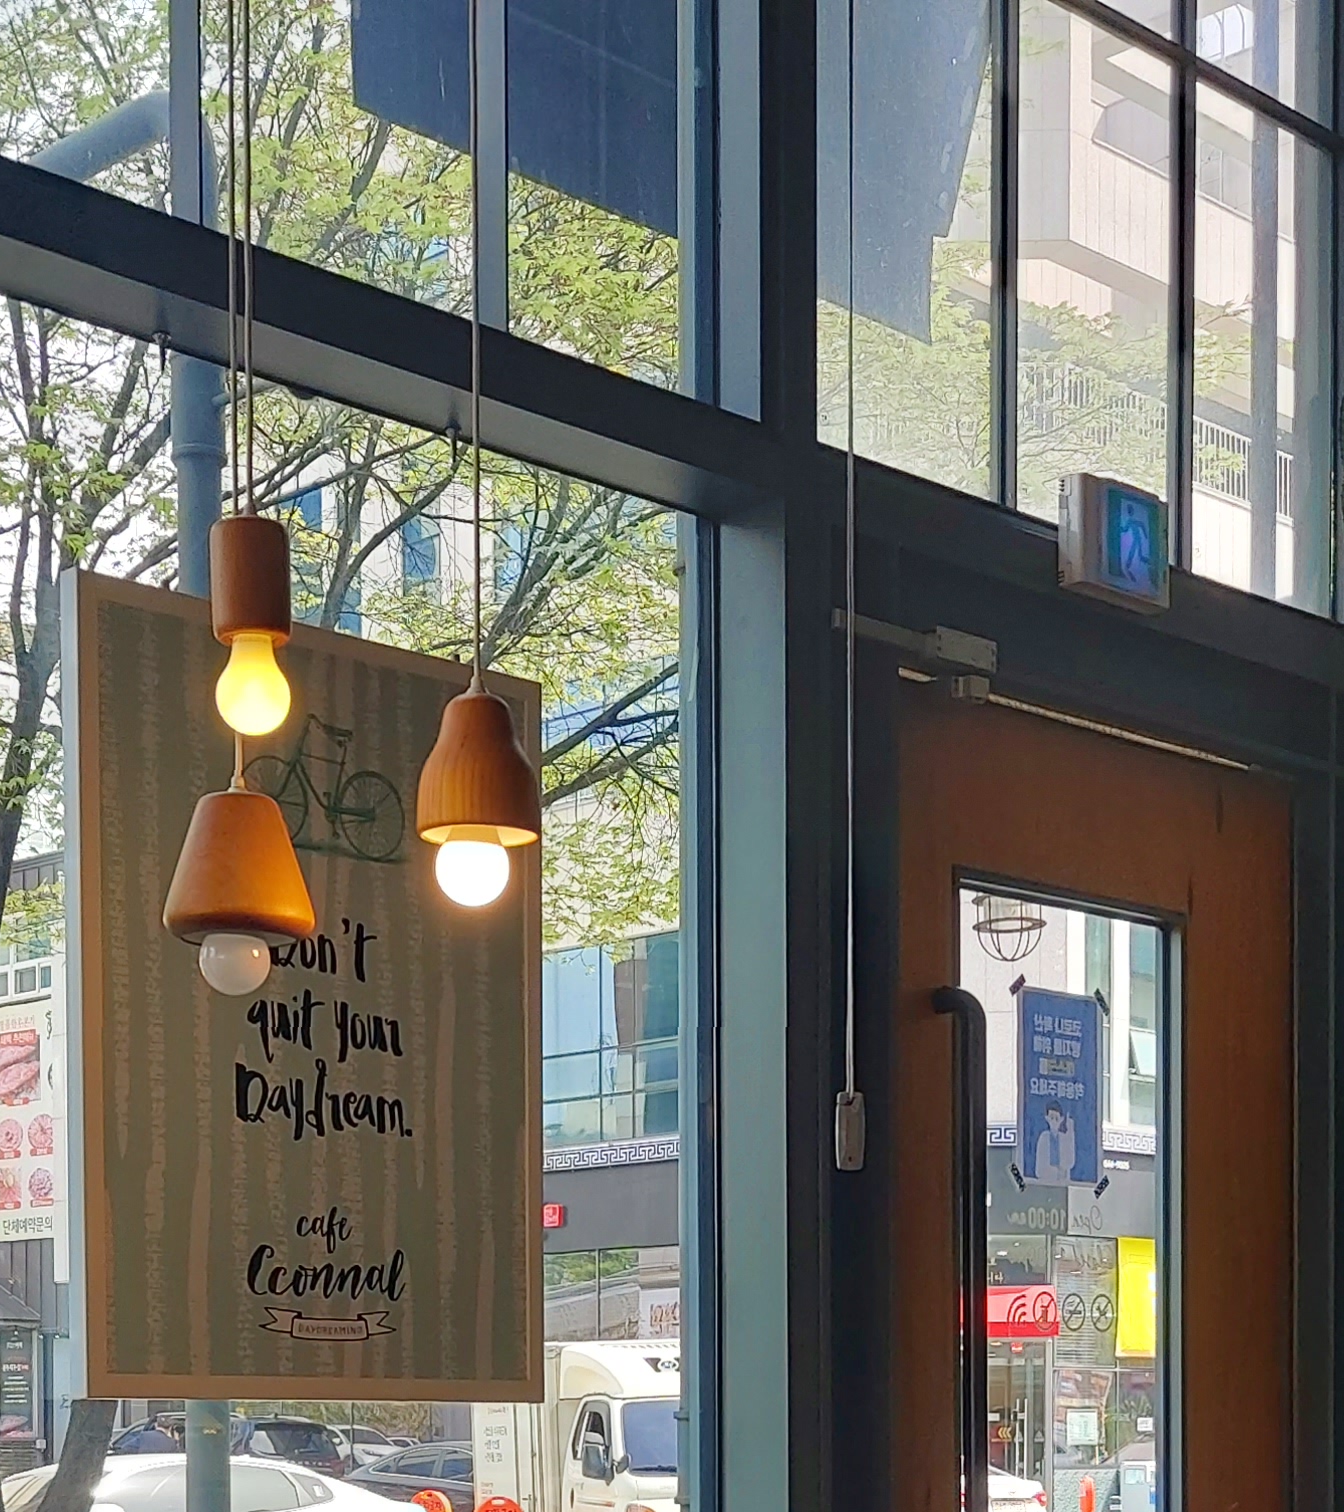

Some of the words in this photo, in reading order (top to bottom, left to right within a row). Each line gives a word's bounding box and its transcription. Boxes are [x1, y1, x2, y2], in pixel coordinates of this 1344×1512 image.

[247, 988, 326, 1064] quit
[333, 1000, 403, 1063] your
[235, 1058, 413, 1141] Daydream.
[2, 1215, 54, 1236] 단체예약문의
[296, 1206, 353, 1254] cafe
